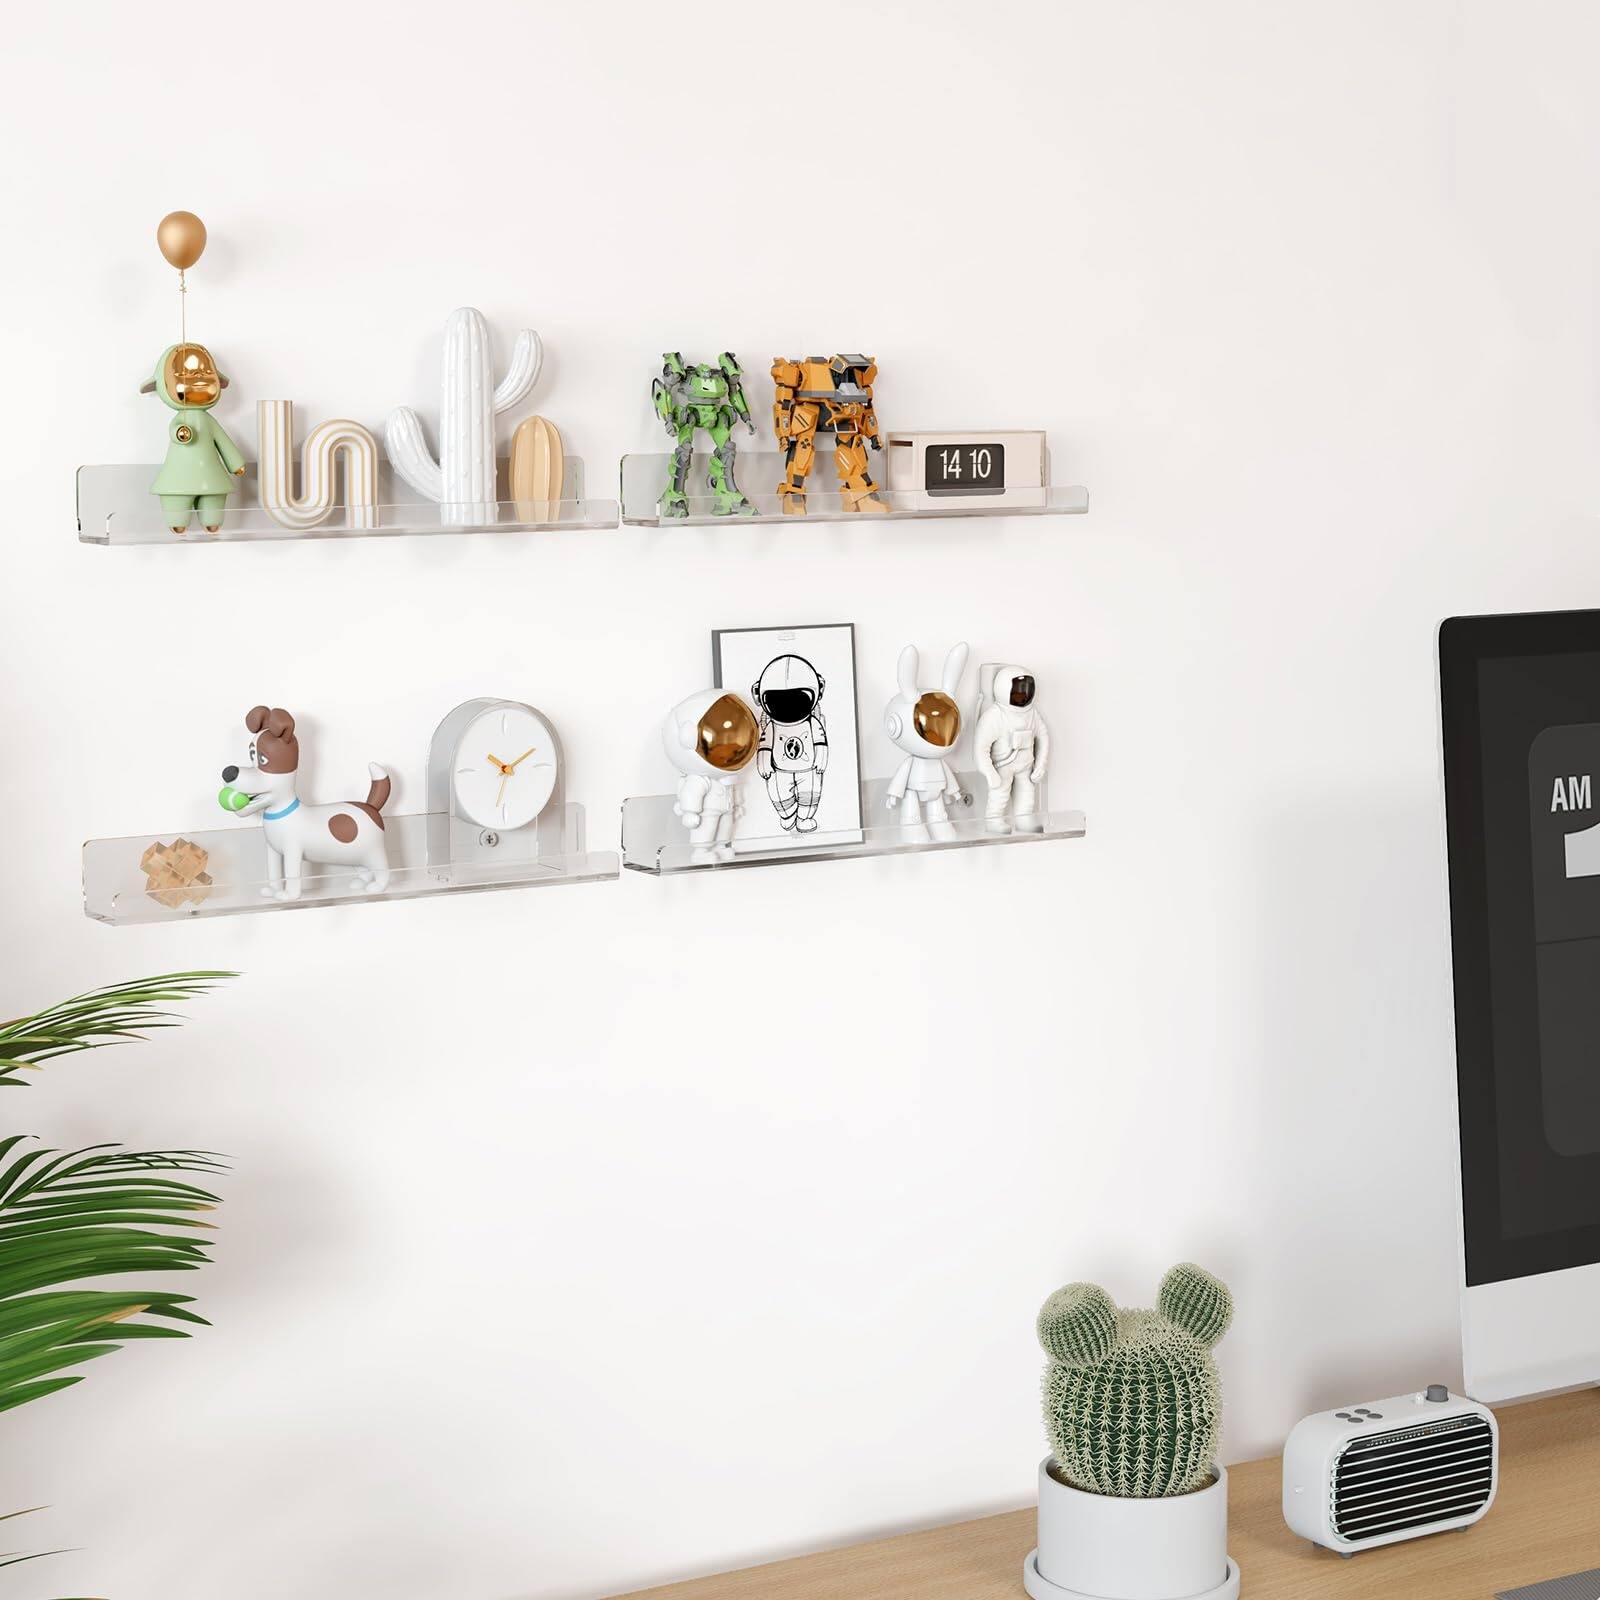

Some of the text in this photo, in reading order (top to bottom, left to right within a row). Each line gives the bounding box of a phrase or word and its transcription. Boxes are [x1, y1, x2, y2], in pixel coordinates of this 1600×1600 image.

[940, 449, 991, 479] 14 10
[1551, 775, 1592, 812] AM
